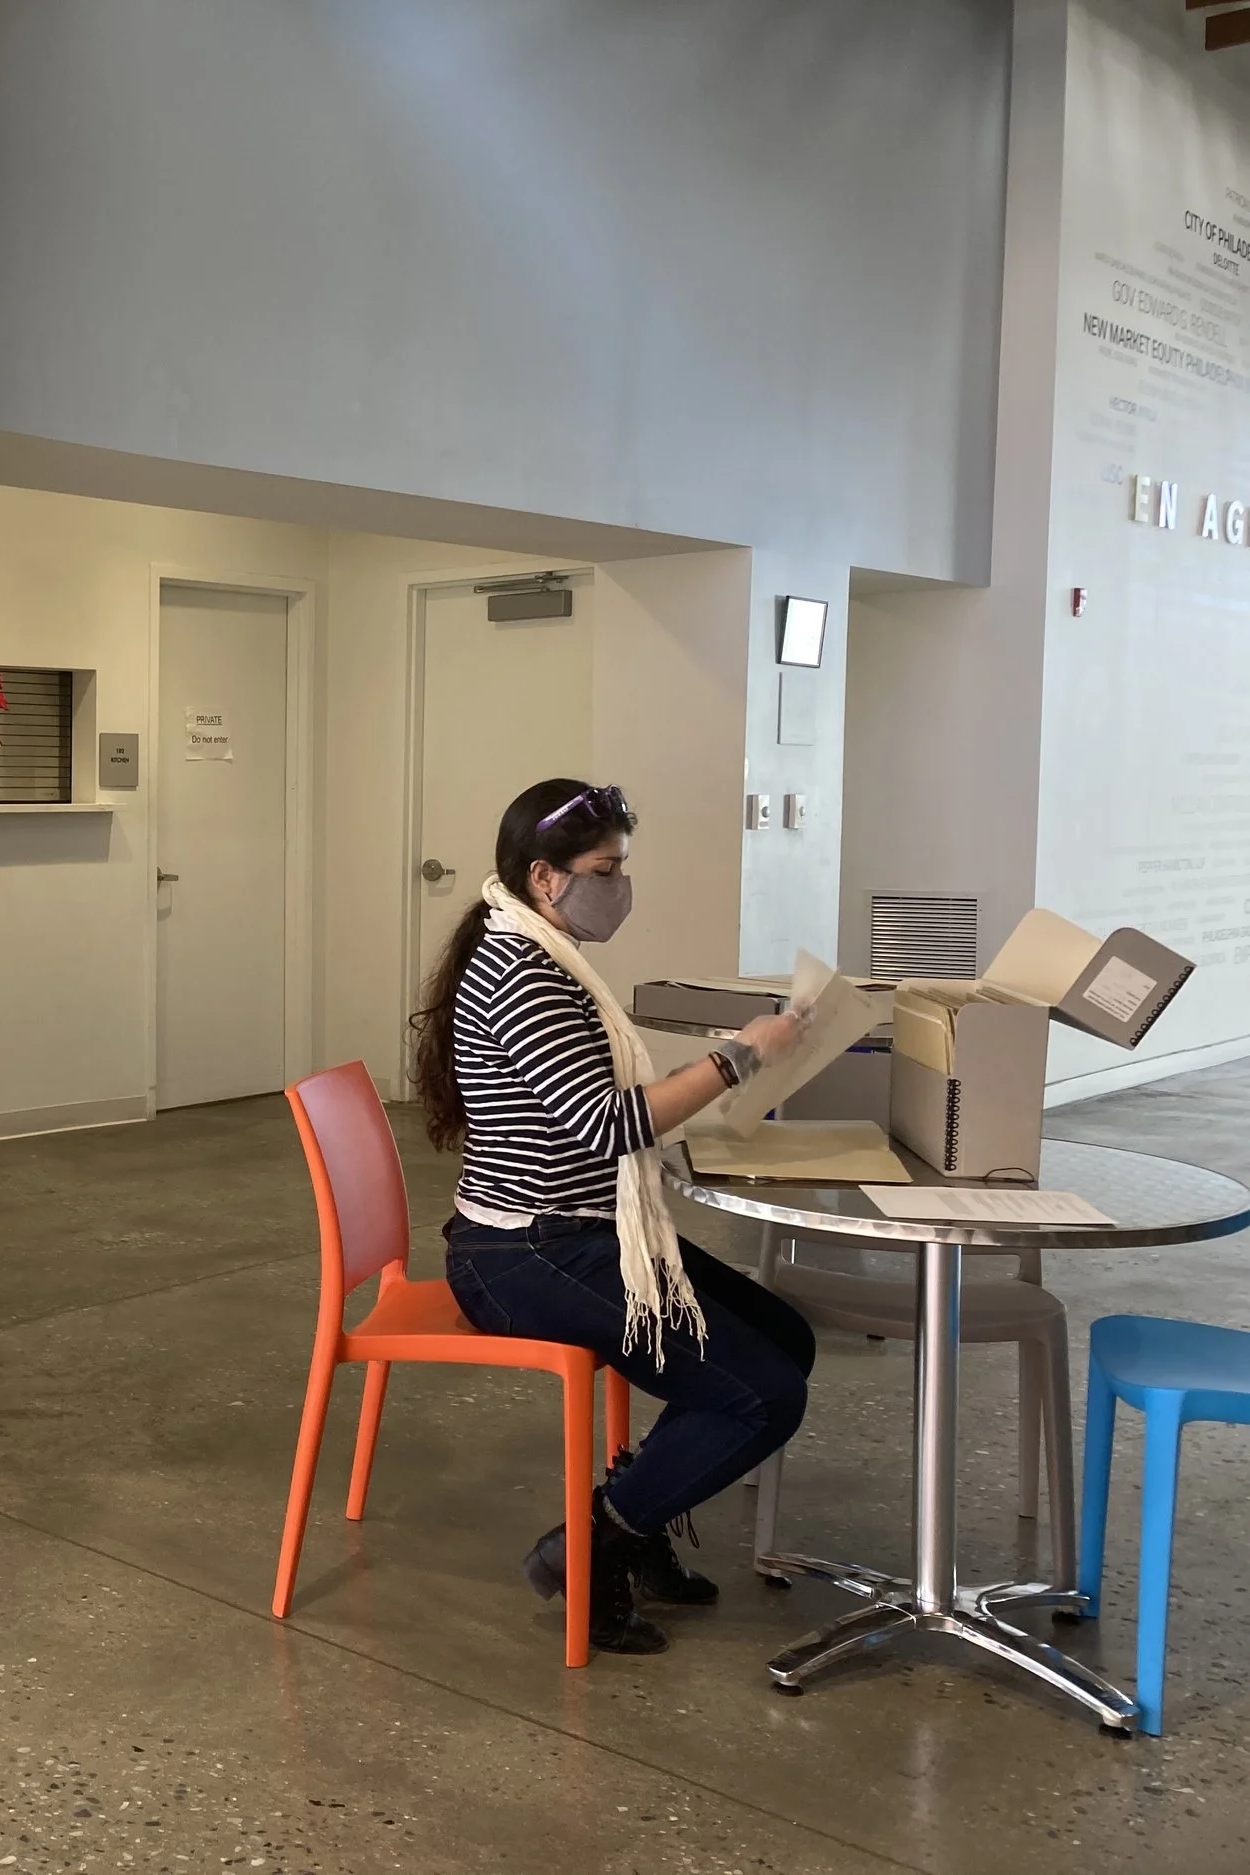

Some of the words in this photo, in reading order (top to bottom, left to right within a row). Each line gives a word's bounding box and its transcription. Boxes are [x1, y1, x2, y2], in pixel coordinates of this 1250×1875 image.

[1184, 210, 1204, 236] CITY
[1205, 221, 1218, 242] OF
[1213, 252, 1240, 277] DELOITTE
[1112, 280, 1137, 306] GOV
[1083, 311, 1108, 340] NEW
[1109, 321, 1151, 356] MARKET
[1152, 338, 1186, 369] EQUITY
[1133, 473, 1179, 531] EN
[1199, 493, 1250, 549] AG
[196, 715, 222, 725] PRIVATE
[191, 735, 201, 744] Do
[202, 736, 213, 744] not
[214, 736, 229, 744] enter
